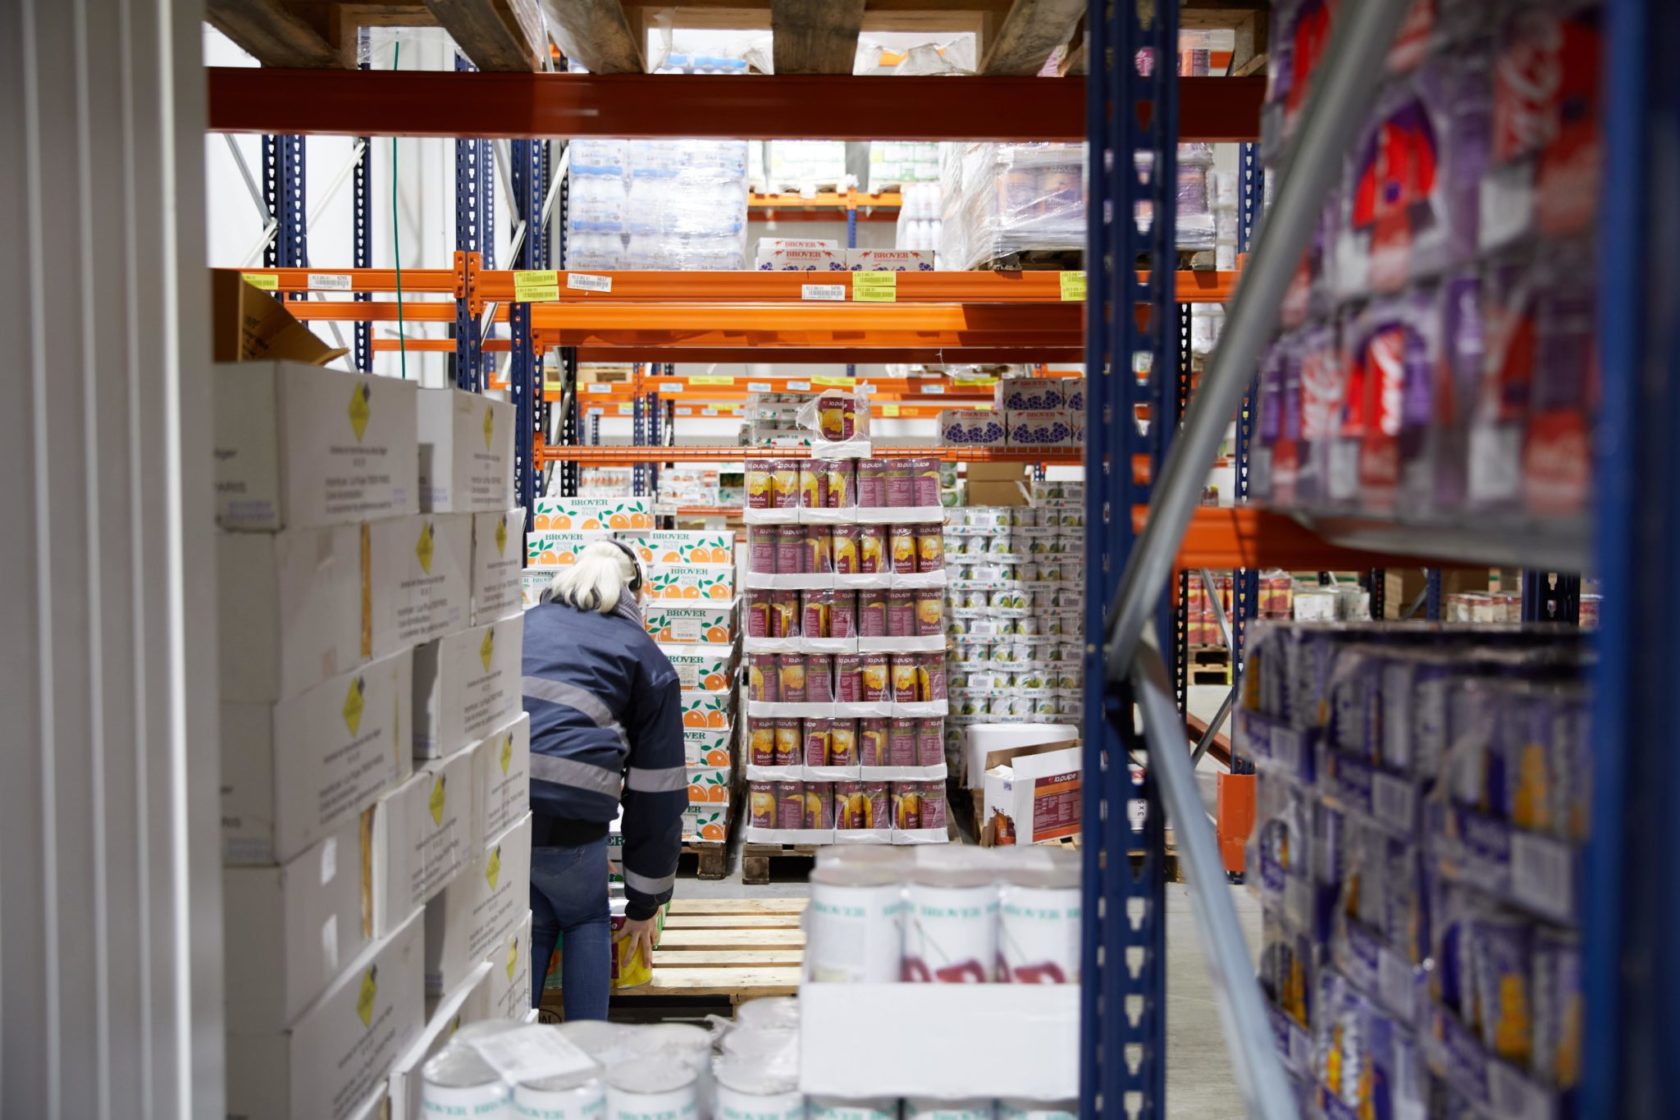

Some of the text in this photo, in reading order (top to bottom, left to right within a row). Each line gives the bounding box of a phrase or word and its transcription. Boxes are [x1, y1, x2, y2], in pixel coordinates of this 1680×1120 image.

[786, 250, 821, 258] BROVER
[873, 251, 909, 259] BROVER
[571, 498, 609, 507] BROVER
[545, 533, 584, 541] BROVER
[670, 568, 709, 576] BROVER
[666, 610, 706, 618] BROVER
